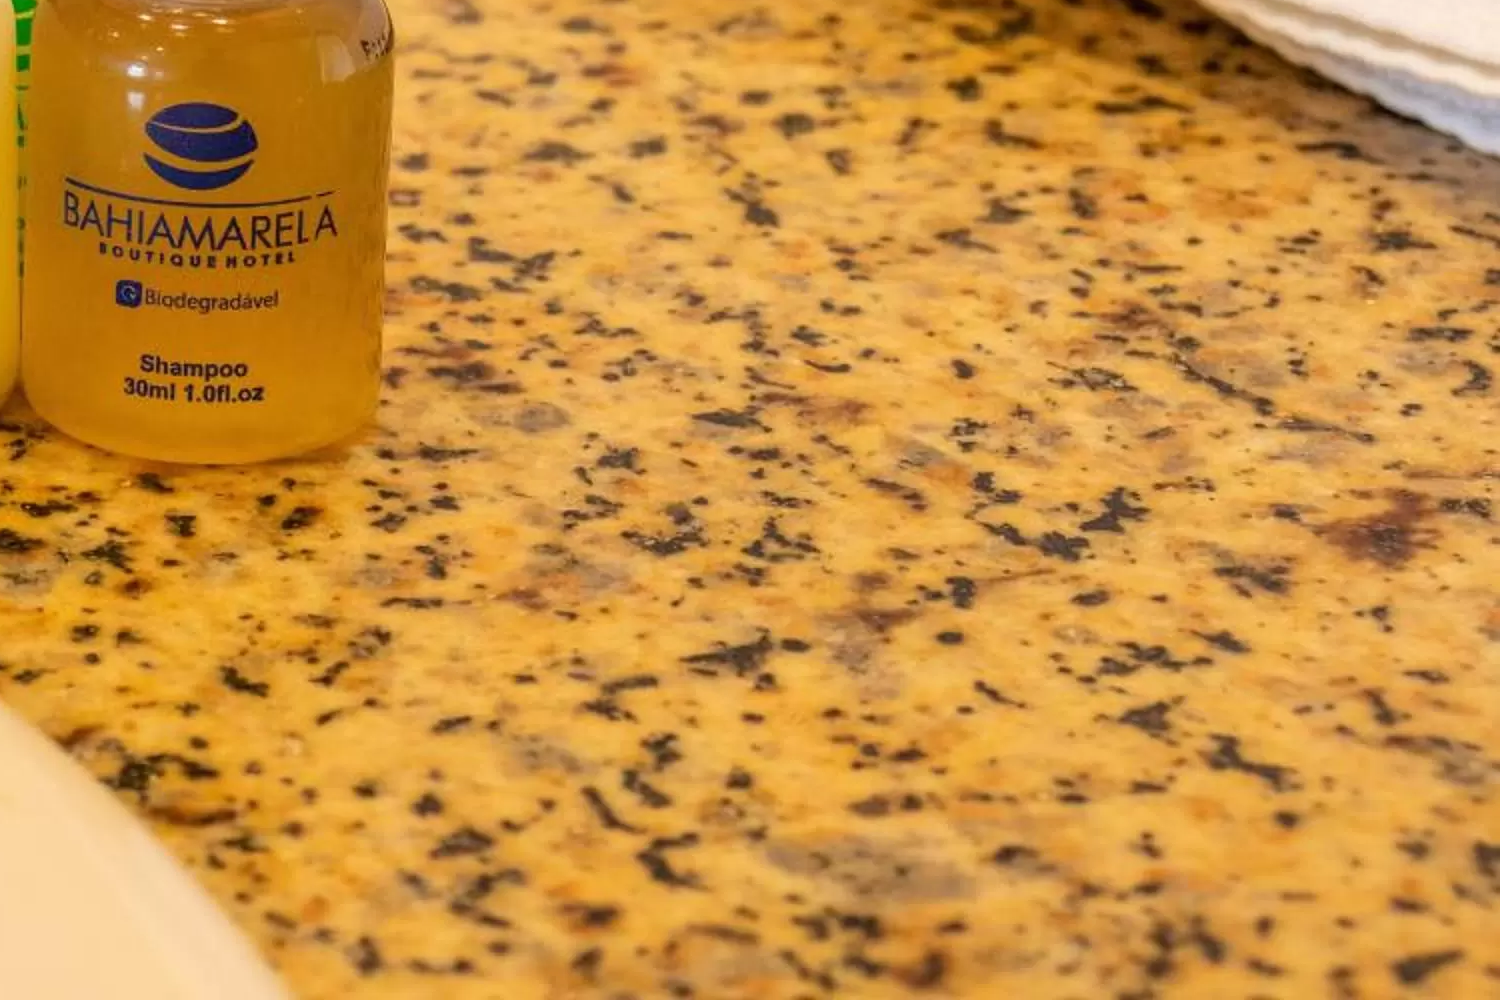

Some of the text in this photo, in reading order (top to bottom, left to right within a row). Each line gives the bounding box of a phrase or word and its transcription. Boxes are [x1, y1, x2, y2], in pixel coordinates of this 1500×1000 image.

[63, 190, 338, 251] BAHIAMARELA
[100, 243, 295, 268] BOUTIQUE HOTEL
[145, 288, 278, 314] Biodegradável
[140, 354, 248, 381] Shampoo
[124, 377, 264, 403] 30ml 1.0fl.oz
